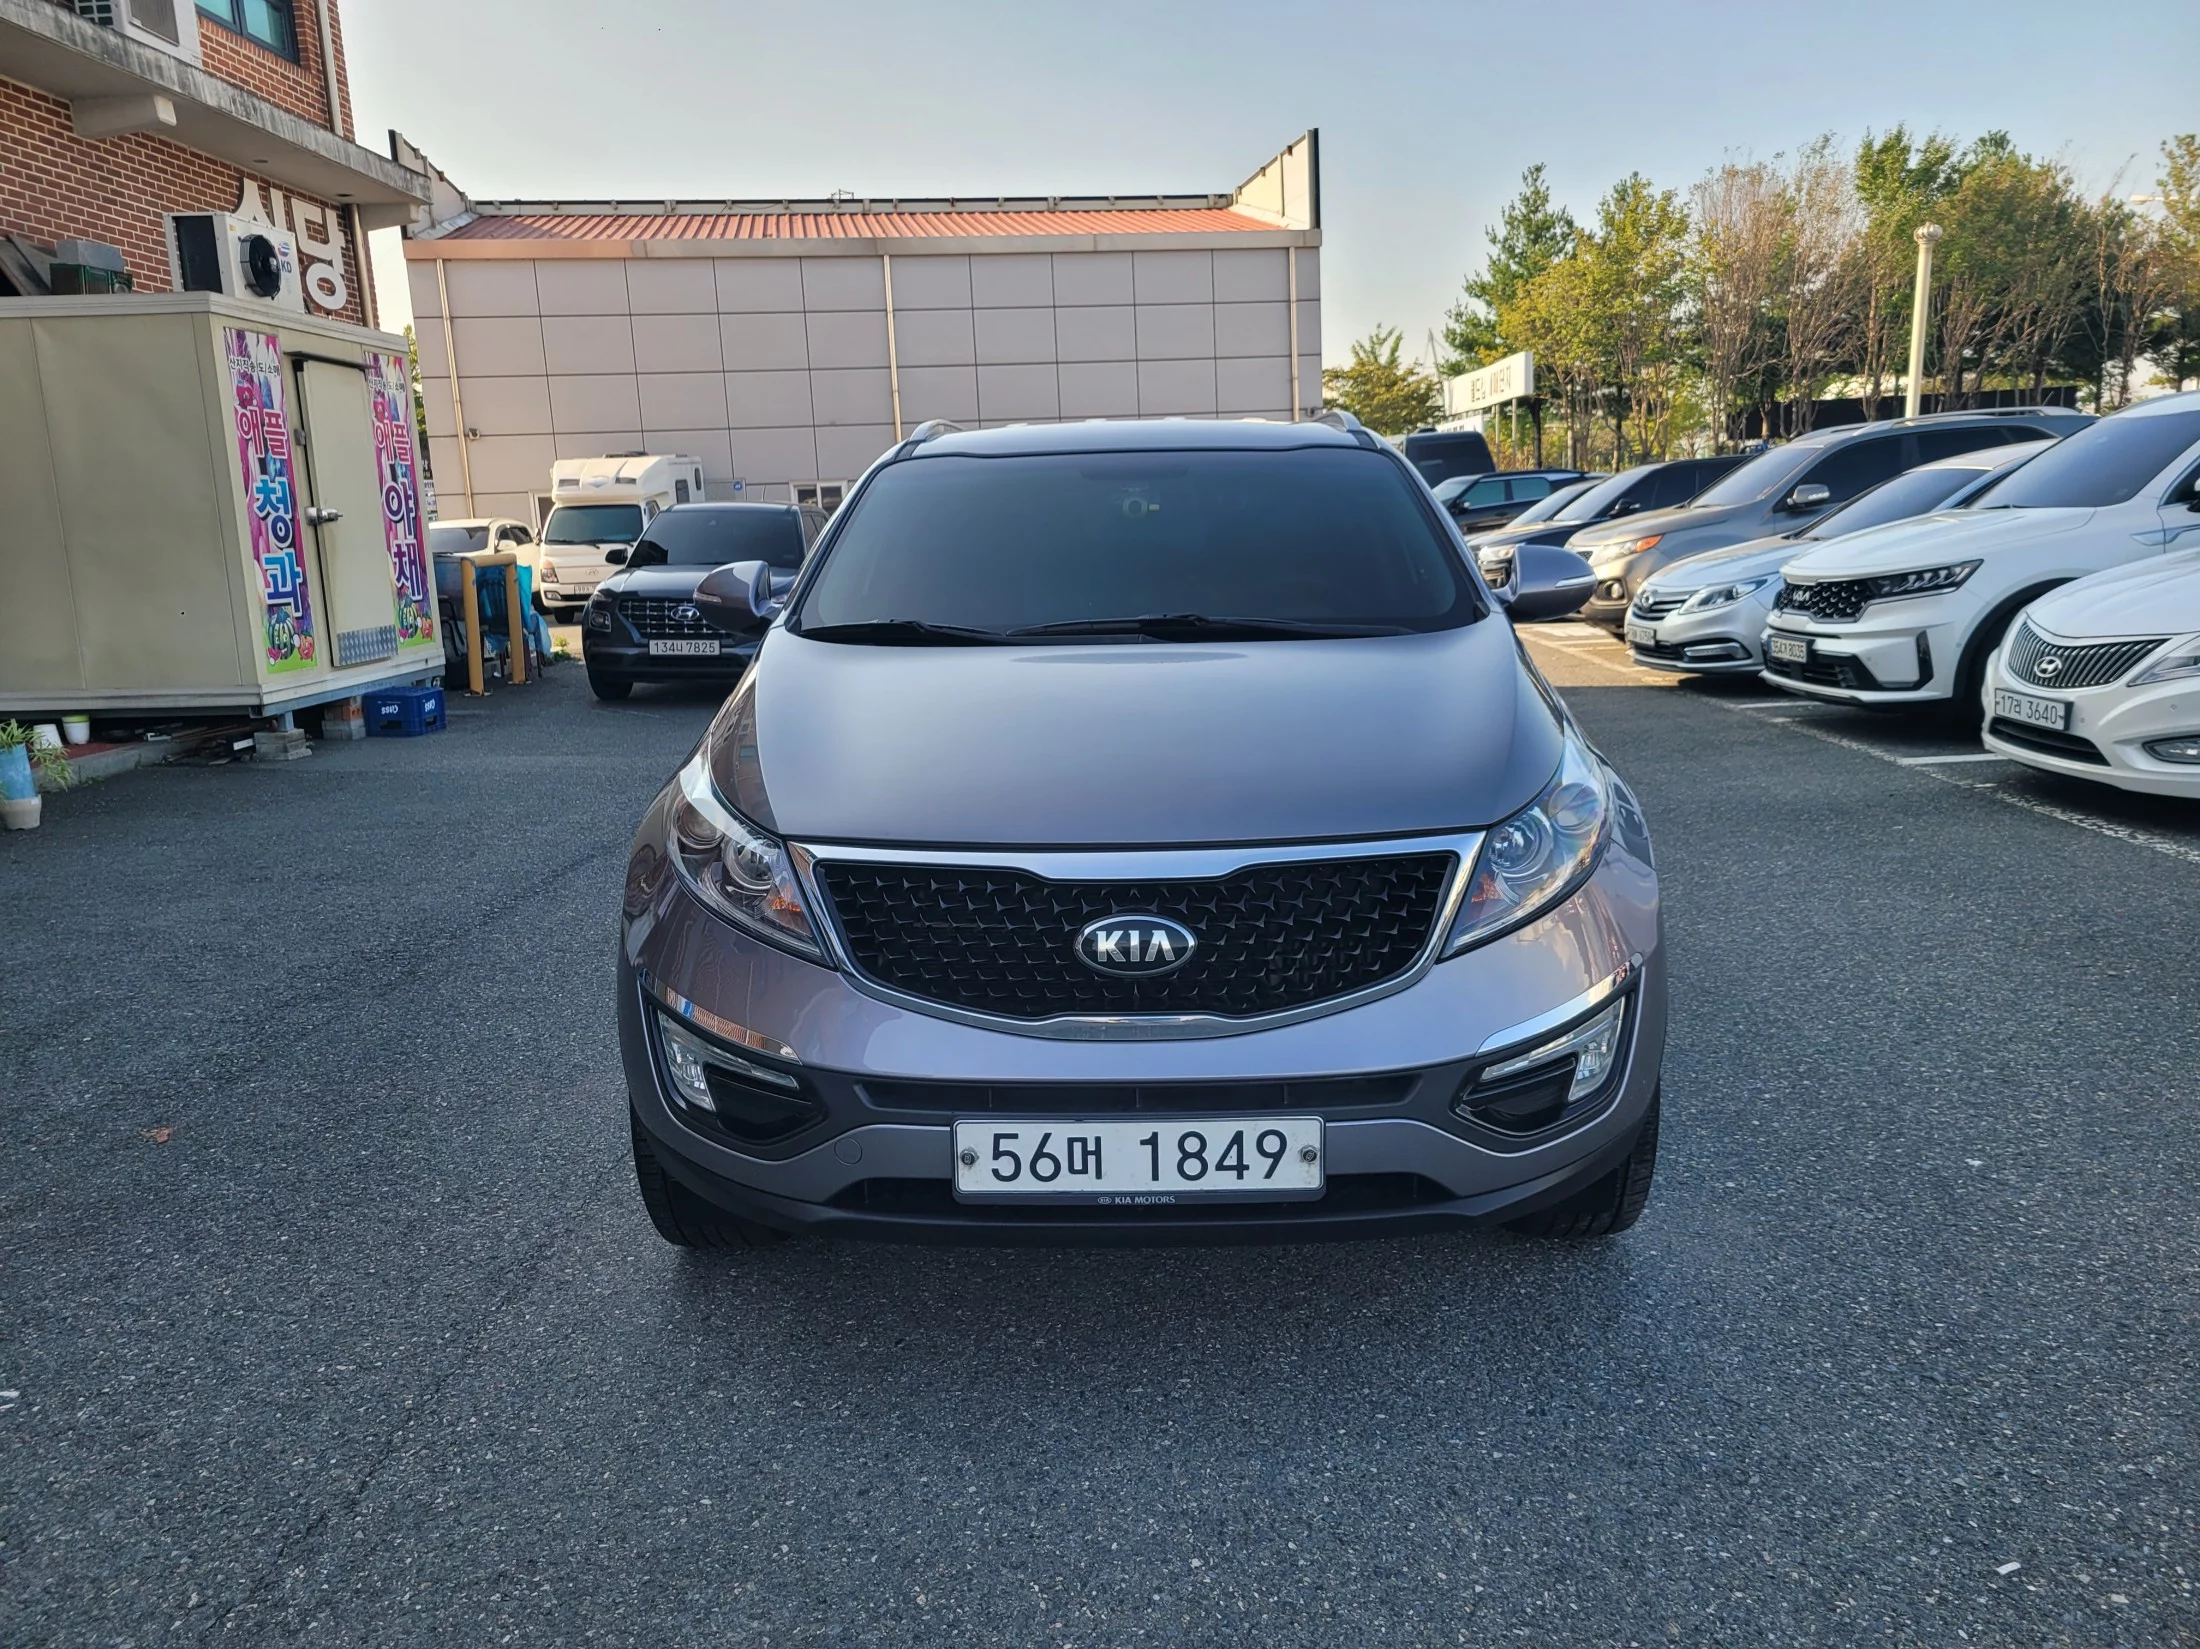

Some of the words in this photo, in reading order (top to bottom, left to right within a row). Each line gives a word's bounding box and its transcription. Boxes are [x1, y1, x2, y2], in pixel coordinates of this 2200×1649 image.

[229, 358, 257, 374] 산지직송
[237, 406, 287, 459] 애플
[374, 419, 411, 465] 애플
[254, 475, 302, 617] 청과
[384, 478, 422, 600] 야채
[686, 642, 716, 653] 7825
[2027, 700, 2058, 725] 3640
[1096, 930, 1175, 962] KIA
[991, 1132, 1102, 1183] 56머
[1139, 1129, 1288, 1182] 1849
[1115, 1196, 1132, 1204] KIA
[1134, 1195, 1175, 1205] MOTORS
